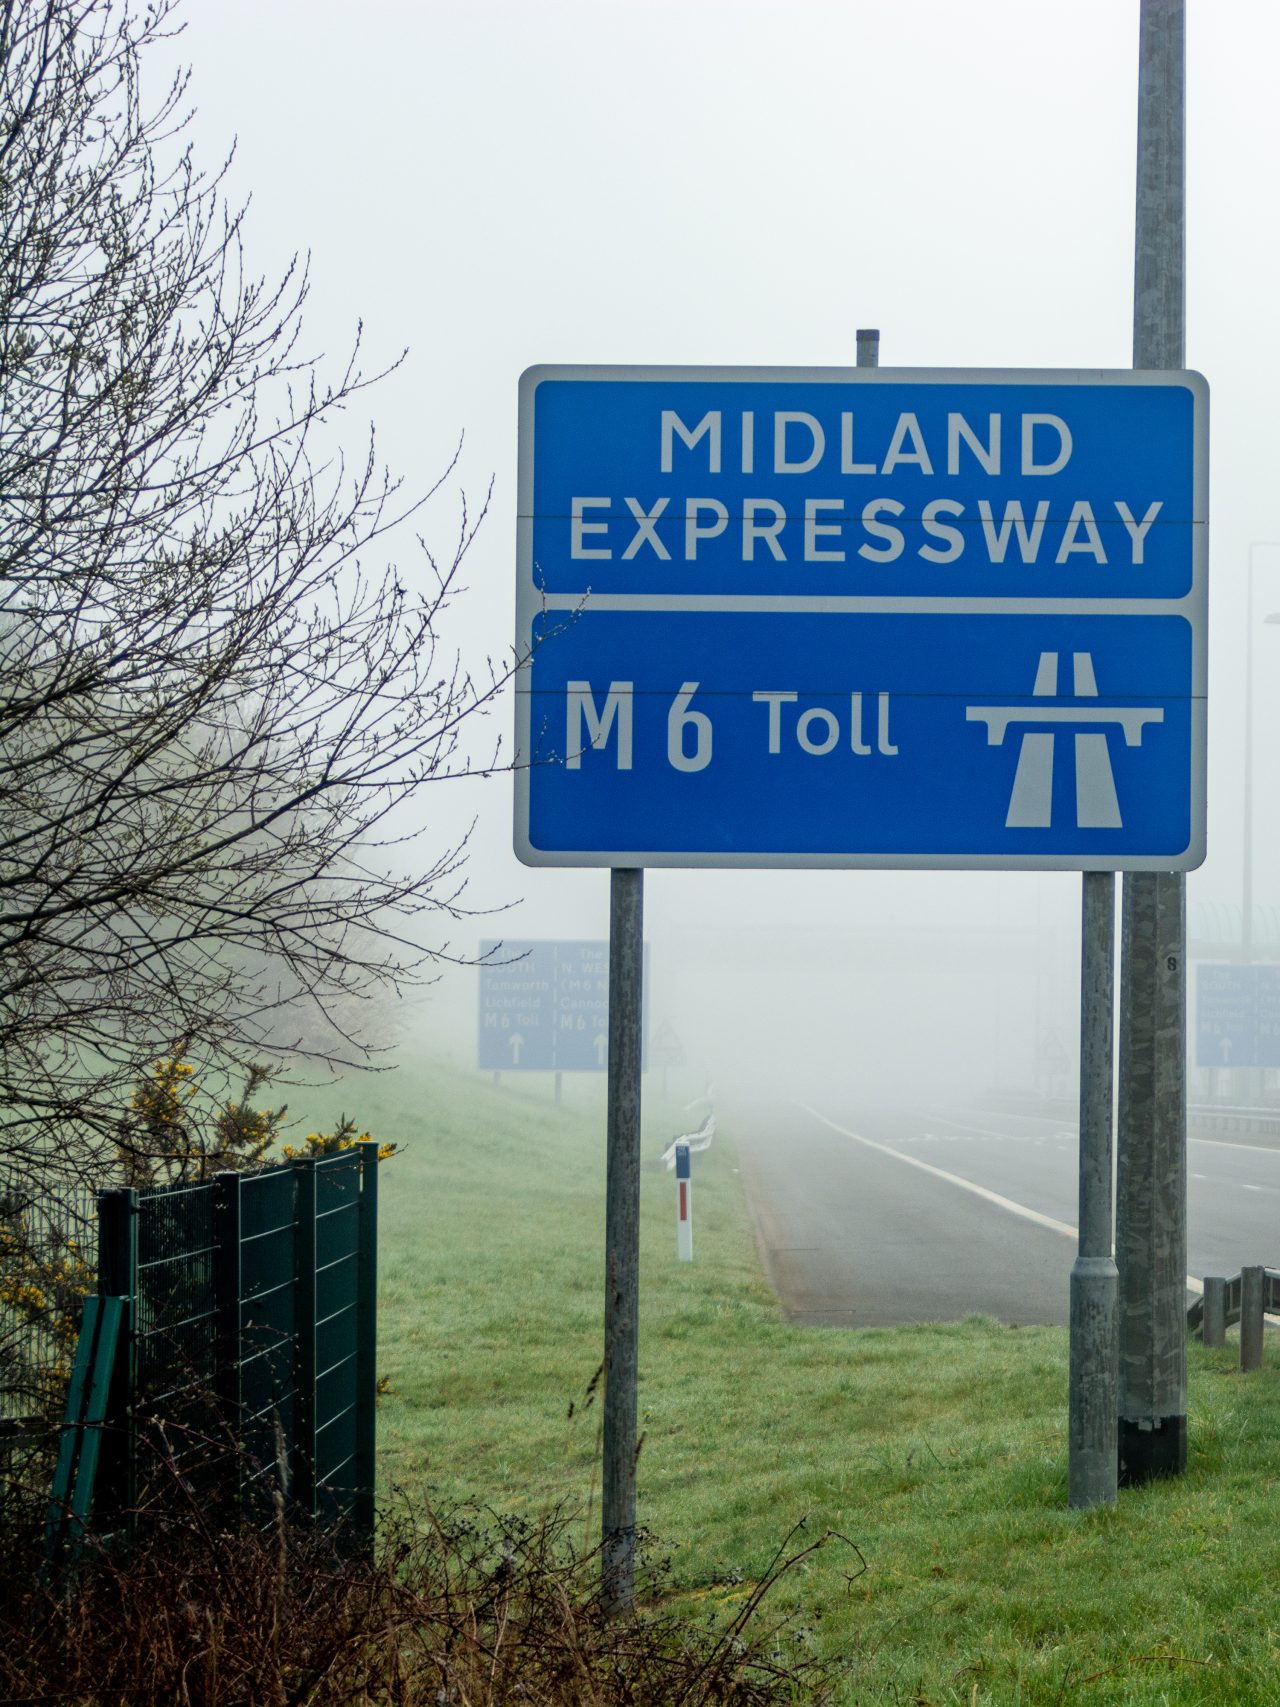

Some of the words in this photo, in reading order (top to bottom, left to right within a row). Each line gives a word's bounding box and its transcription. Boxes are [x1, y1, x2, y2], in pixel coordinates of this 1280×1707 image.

[661, 410, 1073, 476] MIDLAND
[571, 497, 1162, 564] EXPRESSWAY
[566, 680, 633, 771] M
[667, 682, 712, 772] 6
[752, 691, 898, 755] Toll
[487, 978, 549, 992] Tamworth
[486, 996, 541, 1010] Lichfield
[485, 1012, 497, 1028] M
[501, 1013, 510, 1029] 6
[517, 1012, 539, 1026] Toll
[561, 1013, 573, 1030] M
[577, 1013, 587, 1031] 6
